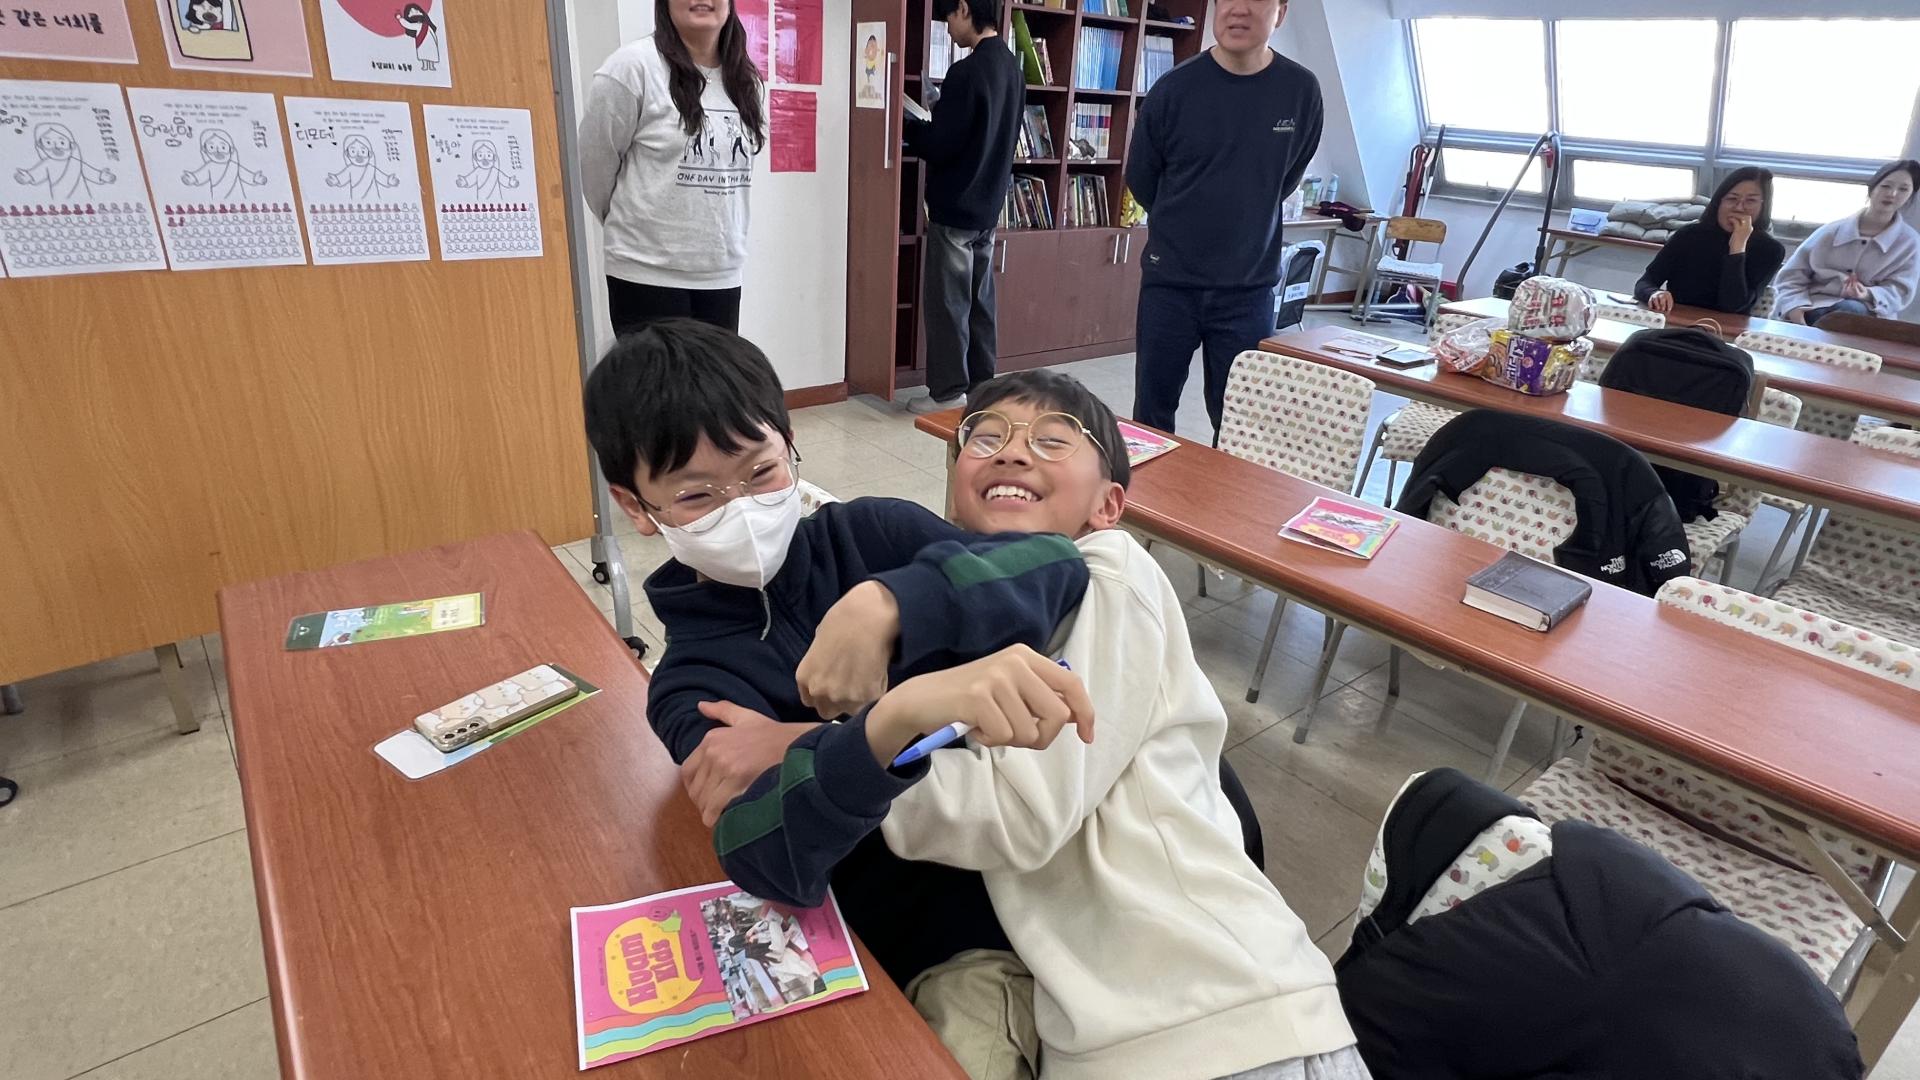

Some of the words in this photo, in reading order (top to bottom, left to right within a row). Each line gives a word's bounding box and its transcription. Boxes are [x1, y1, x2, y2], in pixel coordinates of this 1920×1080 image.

[12, 8, 47, 28] 같은
[53, 12, 104, 34] 너희를
[296, 127, 335, 141] 디모데
[677, 172, 696, 182] ONE
[697, 174, 715, 183] DAY
[718, 175, 726, 184] IN
[620, 932, 658, 1007] Huam
[648, 939, 679, 984] Kids
